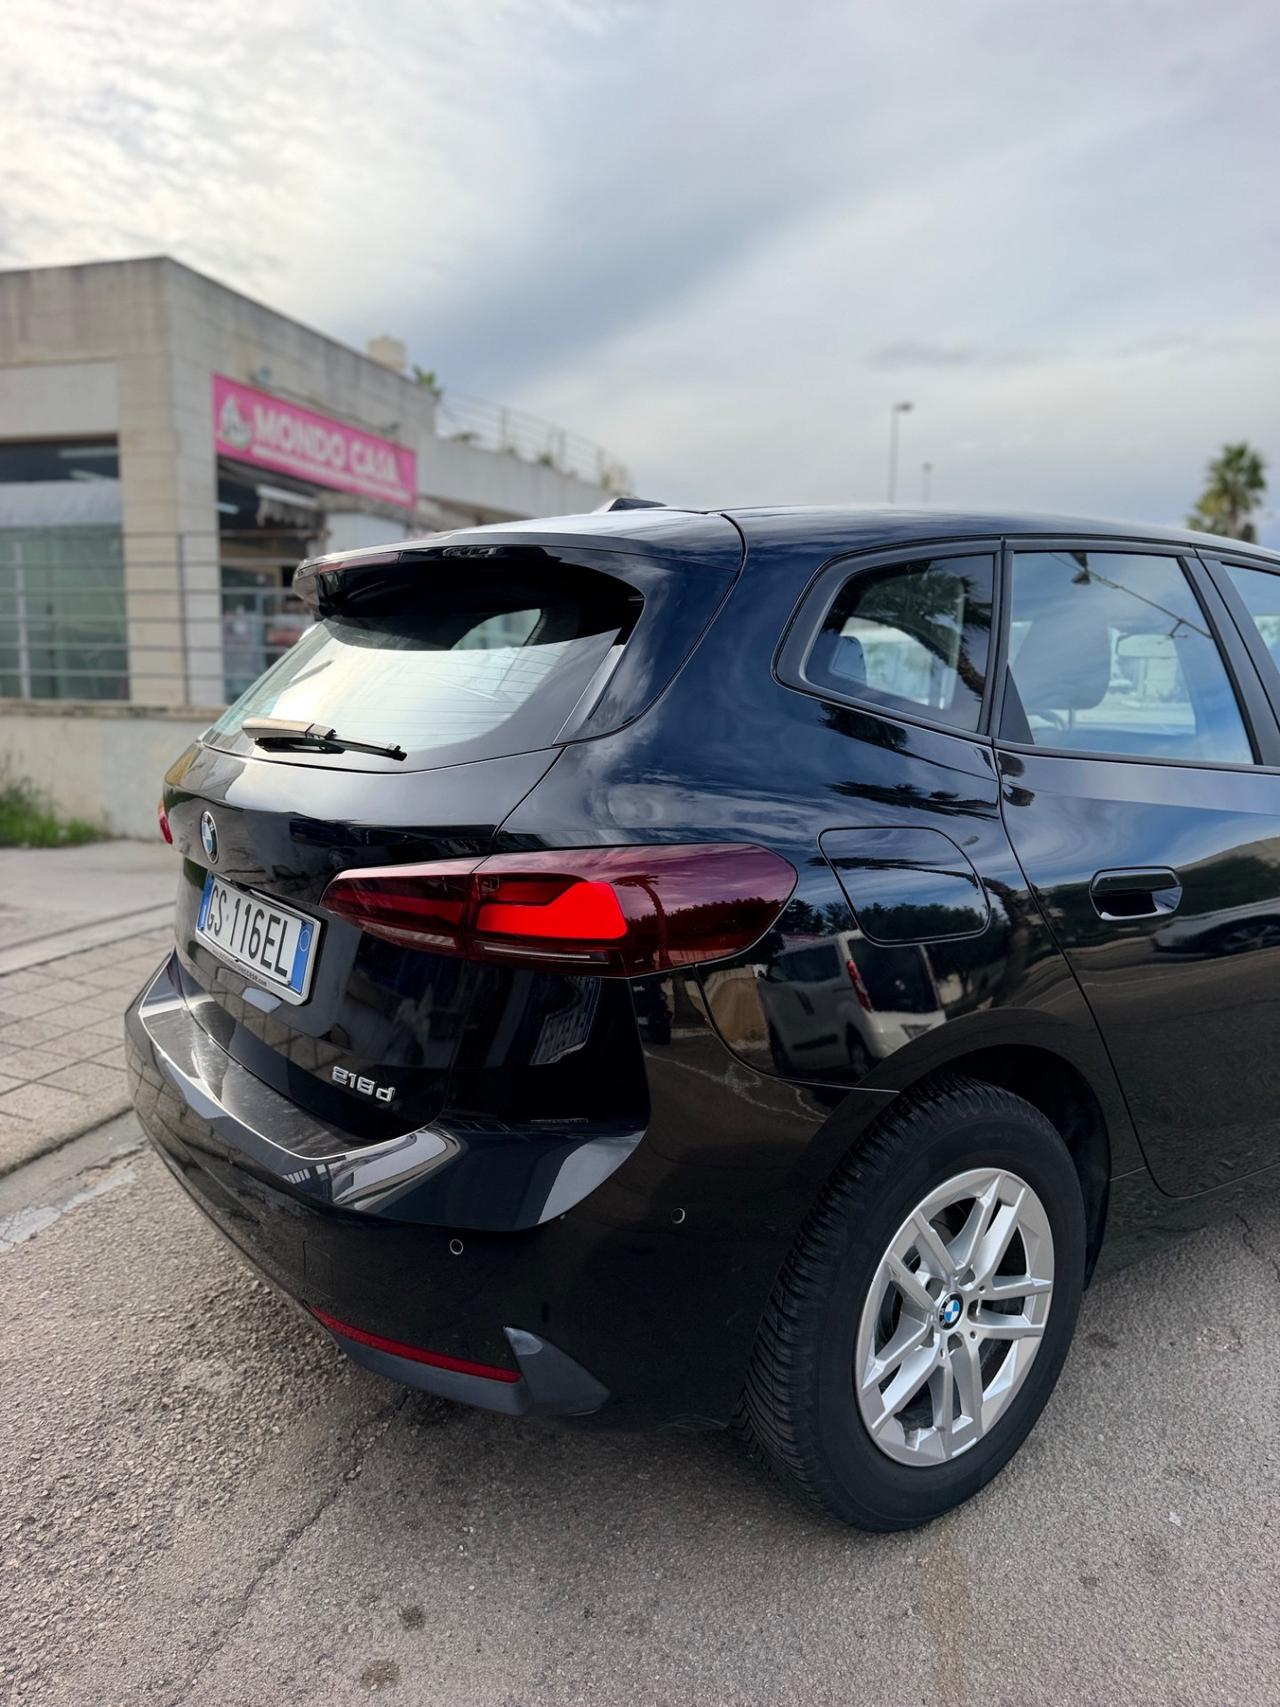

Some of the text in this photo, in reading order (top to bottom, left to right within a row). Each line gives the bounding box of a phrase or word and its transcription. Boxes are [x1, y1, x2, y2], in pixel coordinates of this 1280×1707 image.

[252, 404, 346, 468] MONDO
[206, 884, 227, 937] GS
[229, 898, 288, 978] 116EL
